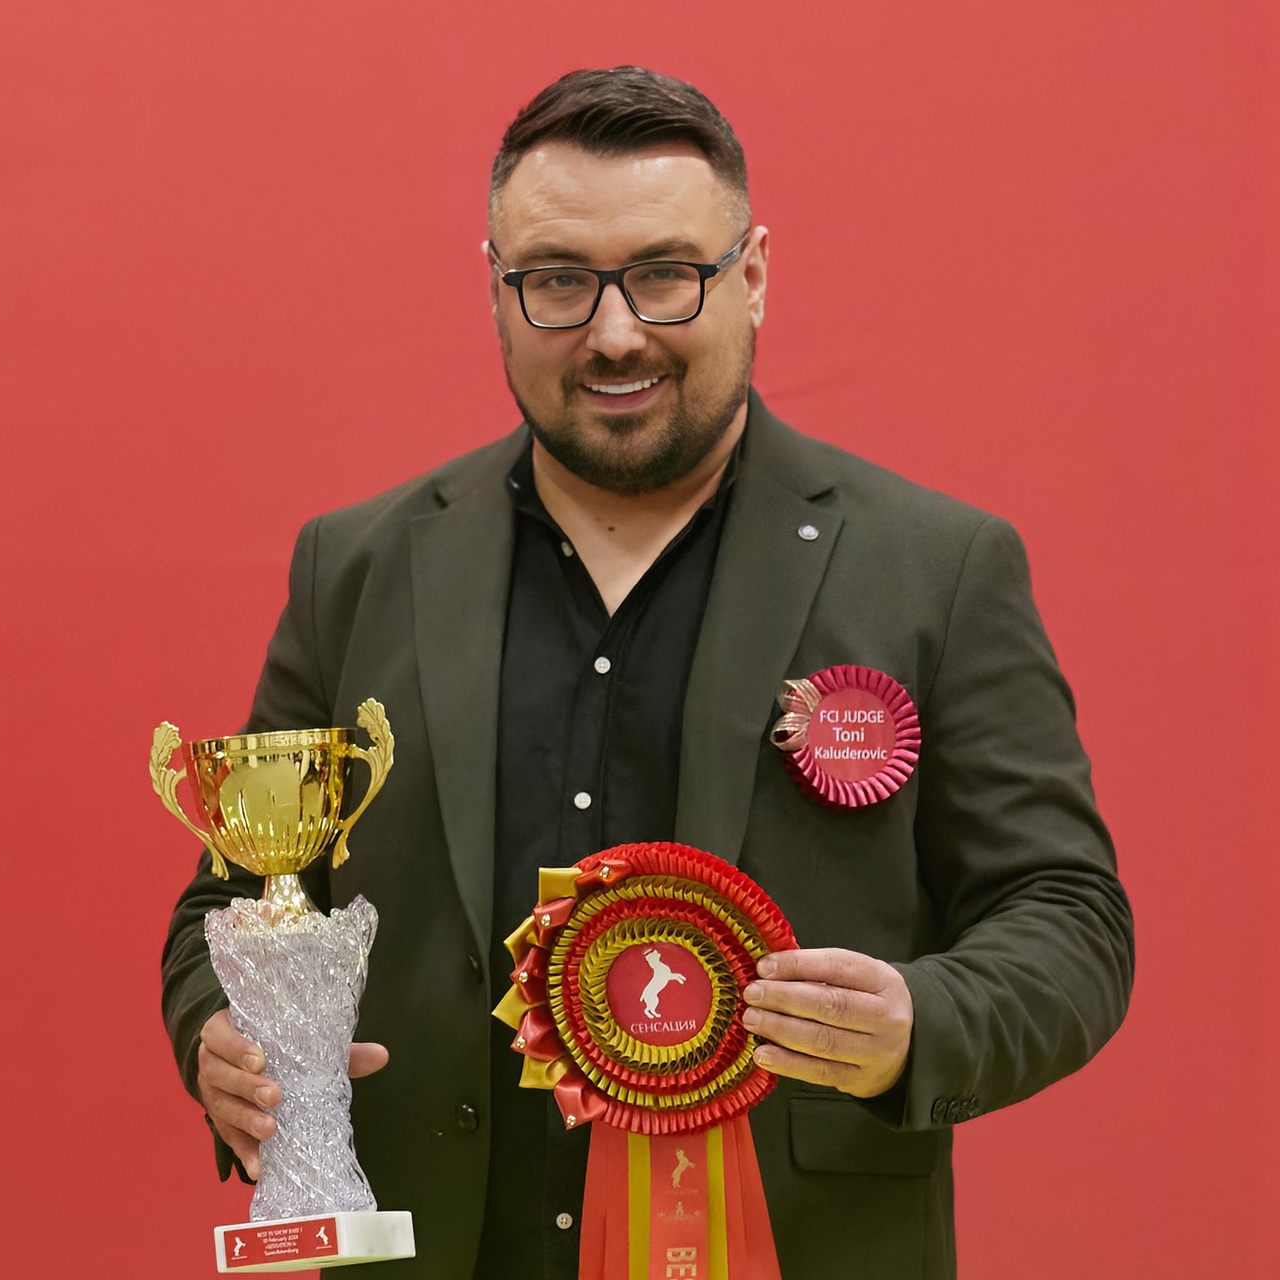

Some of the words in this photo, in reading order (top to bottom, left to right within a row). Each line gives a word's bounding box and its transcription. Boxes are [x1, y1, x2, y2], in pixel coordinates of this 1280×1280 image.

[819, 709, 839, 724] FCI
[841, 709, 886, 724] JUDGE
[832, 726, 866, 743] Toni
[814, 746, 889, 760] Kaluderovic
[629, 1019, 697, 1034] СЕНСАЦИЯ
